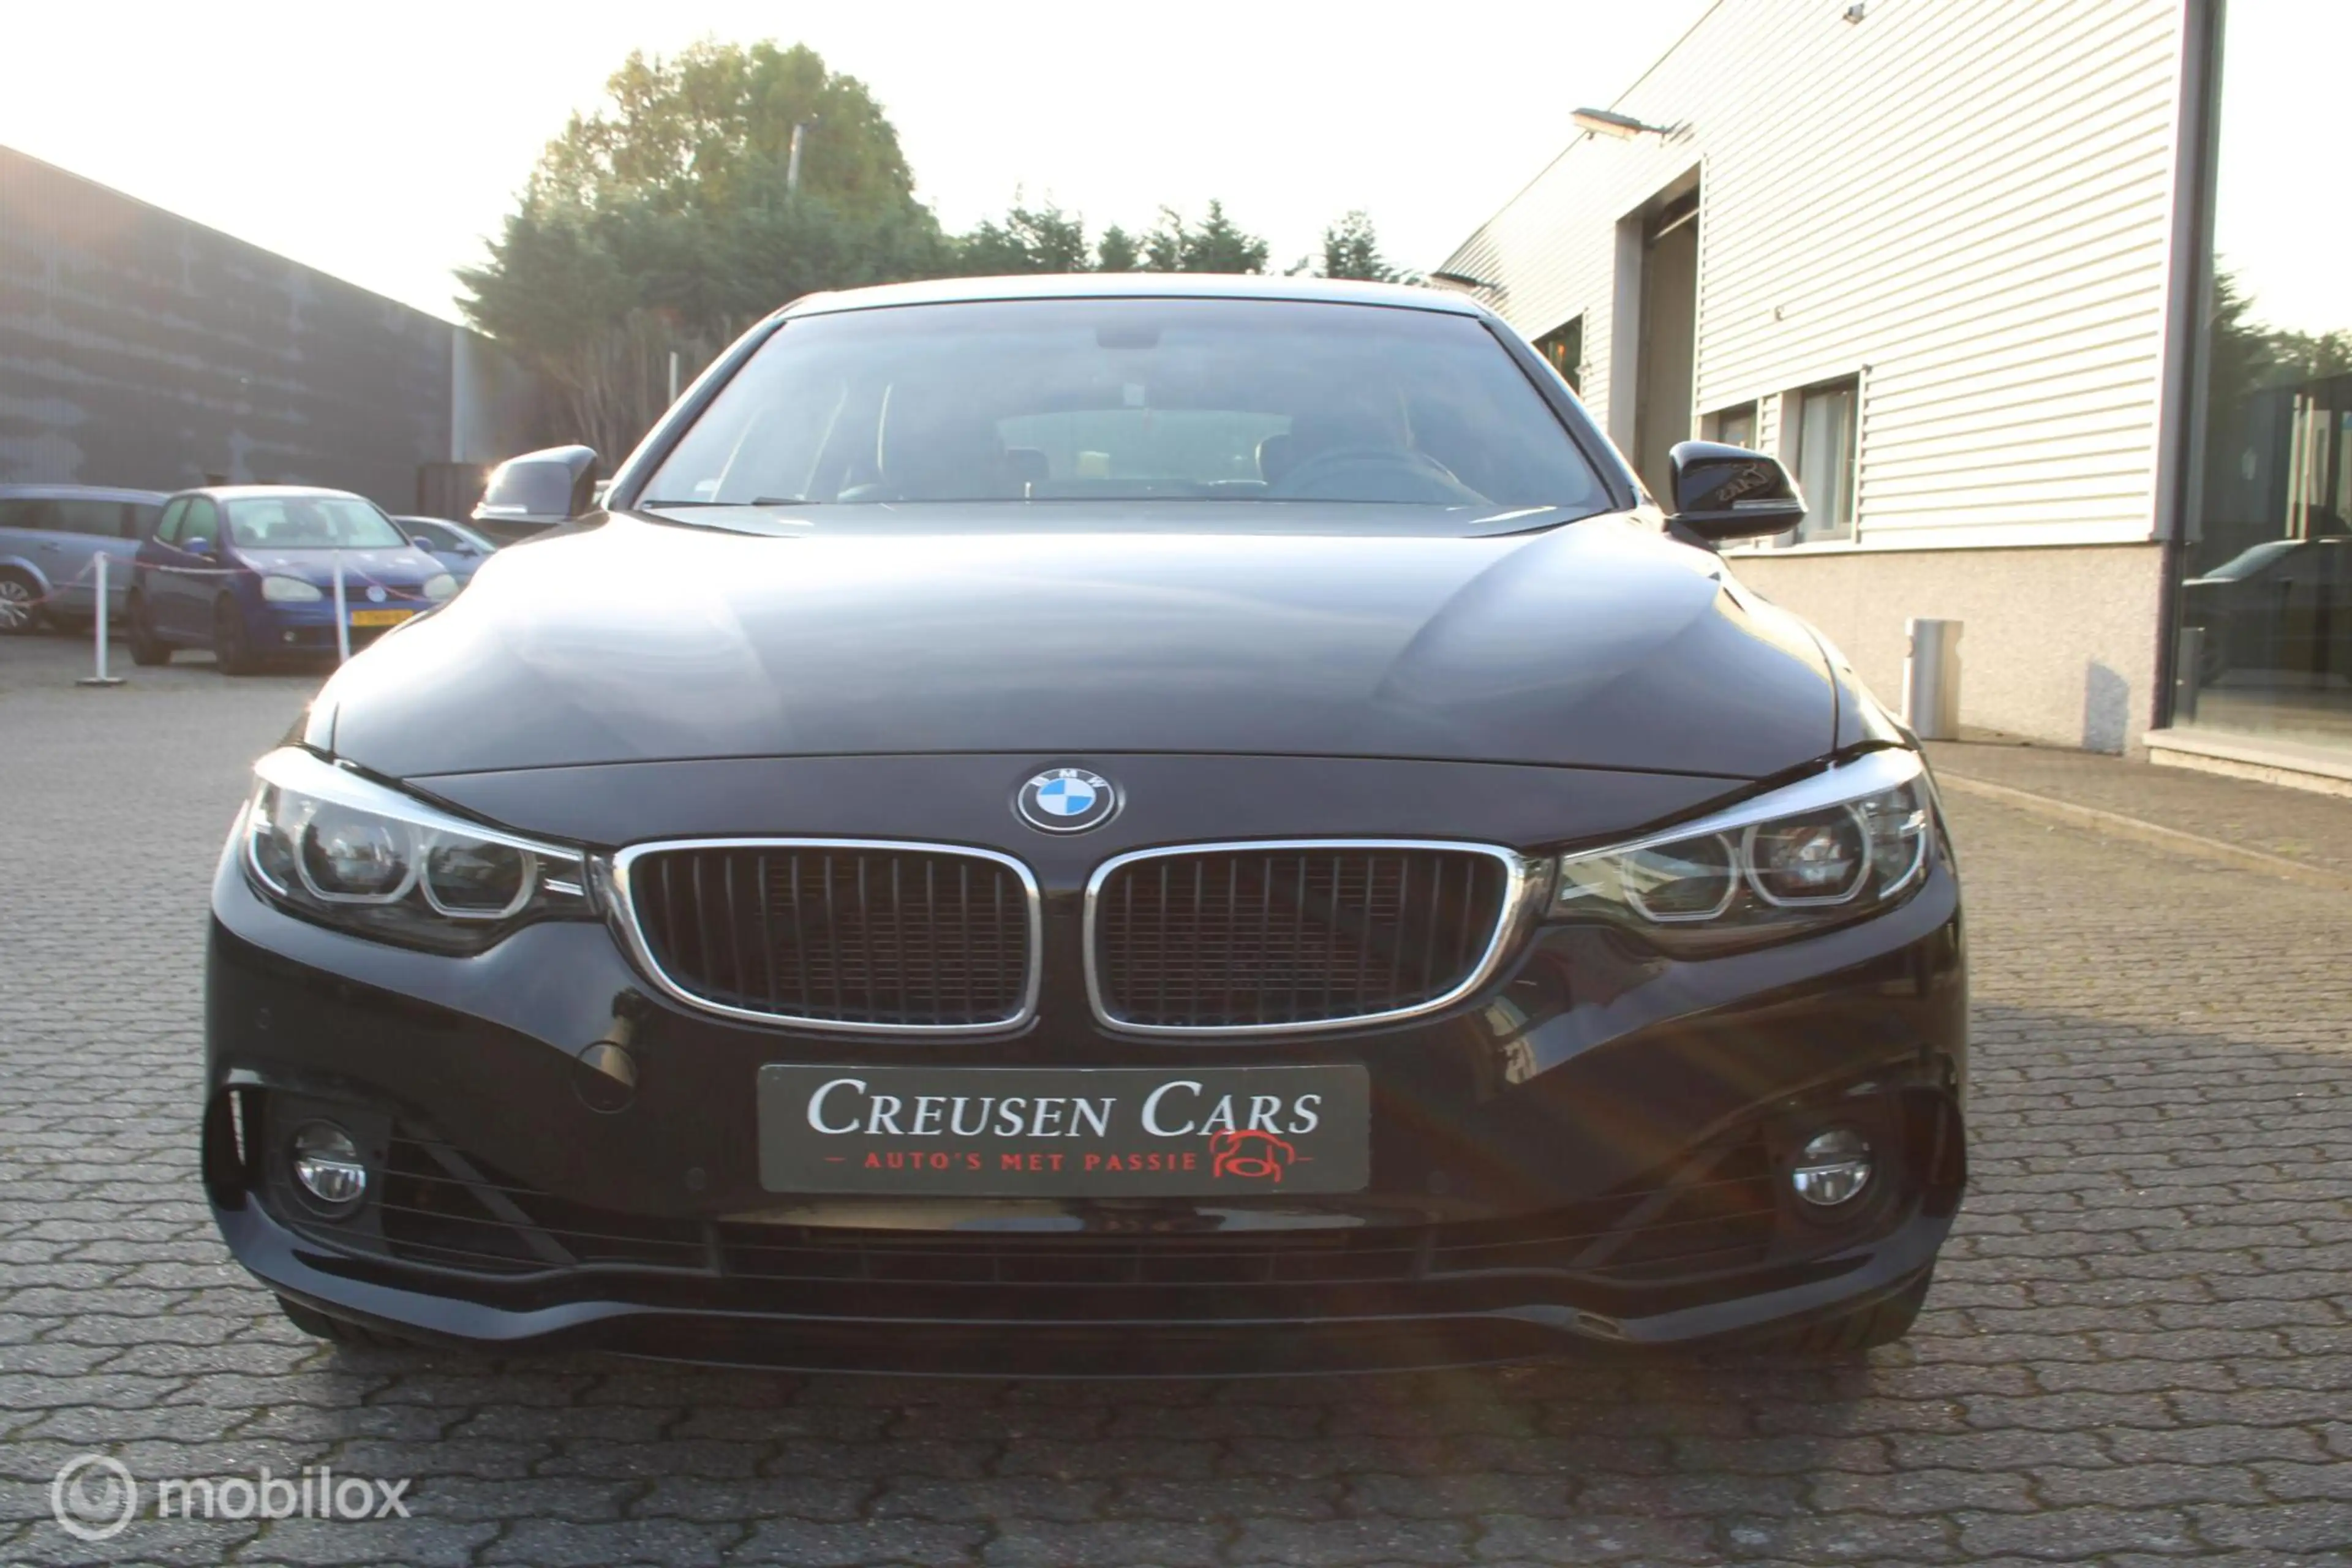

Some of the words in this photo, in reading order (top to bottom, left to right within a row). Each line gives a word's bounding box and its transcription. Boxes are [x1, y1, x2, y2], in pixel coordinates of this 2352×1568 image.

[807, 1078, 1117, 1137] CREUSEN
[1142, 1080, 1322, 1137] CARS
[864, 1151, 981, 1170] AUTO'S
[1000, 1153, 1063, 1171] MET
[1084, 1153, 1197, 1171] PASSIE
